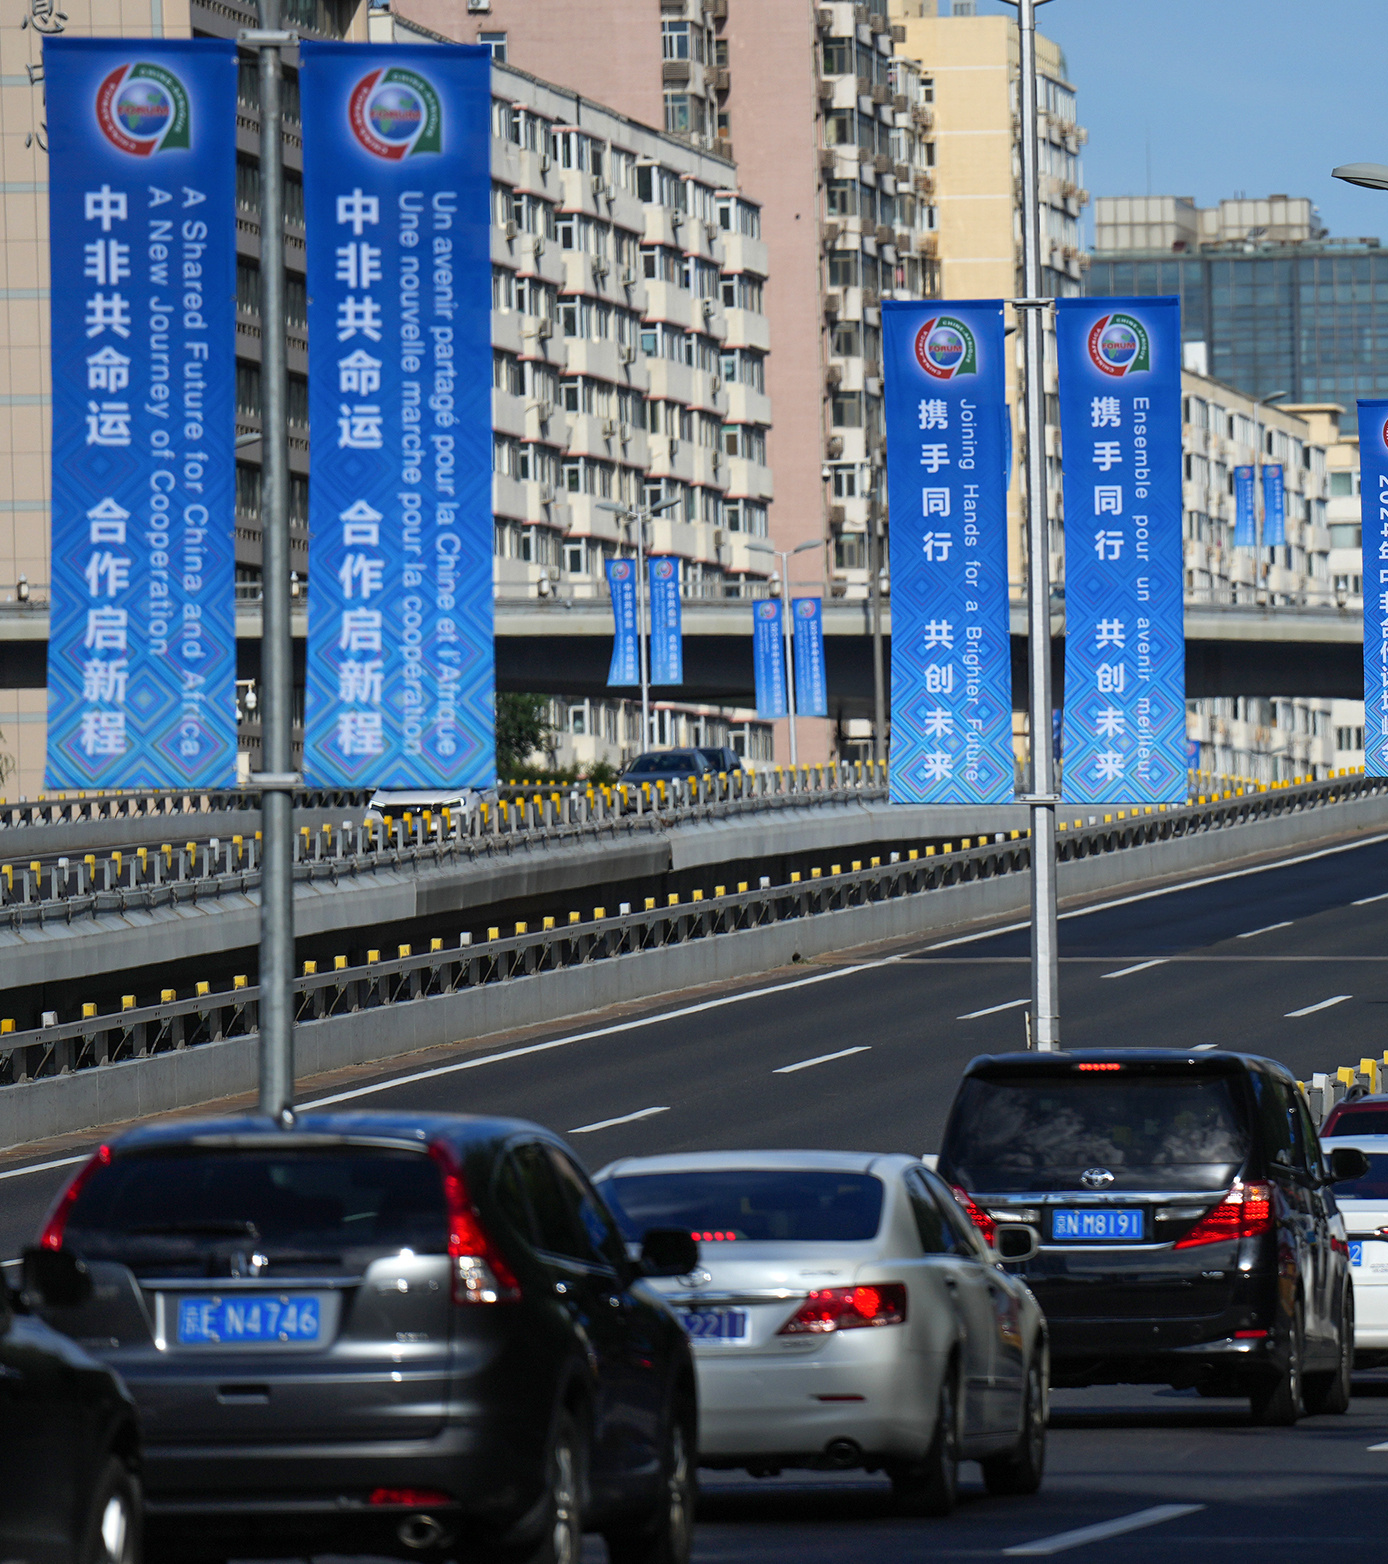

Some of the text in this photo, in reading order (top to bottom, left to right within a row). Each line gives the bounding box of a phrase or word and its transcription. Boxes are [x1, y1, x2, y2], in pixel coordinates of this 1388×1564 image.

[433, 193, 457, 229] Un
[434, 246, 458, 319] avenir
[145, 187, 175, 656] A New Journey of Cooperation
[430, 327, 459, 427] partagé
[432, 436, 454, 494] pour
[928, 344, 963, 353] FORUM
[1101, 341, 1136, 350] FORUM
[82, 186, 131, 754] 中非共命运 合作启新程
[179, 188, 208, 755] A Shared Future for China and Africa
[337, 189, 384, 754] 中非共命运 合作启新程
[396, 192, 428, 758] Une nouvelle marche pour la coopération
[436, 533, 461, 610] Chine
[437, 503, 459, 525] la
[1091, 397, 1127, 782] 携手同行 共创未来
[1133, 398, 1153, 780] Ensemble pour un avenir meilleur
[437, 618, 459, 642] et
[919, 400, 954, 782] 携手同行 共创未来
[959, 399, 984, 784] Joining Hands for a Brighter Future
